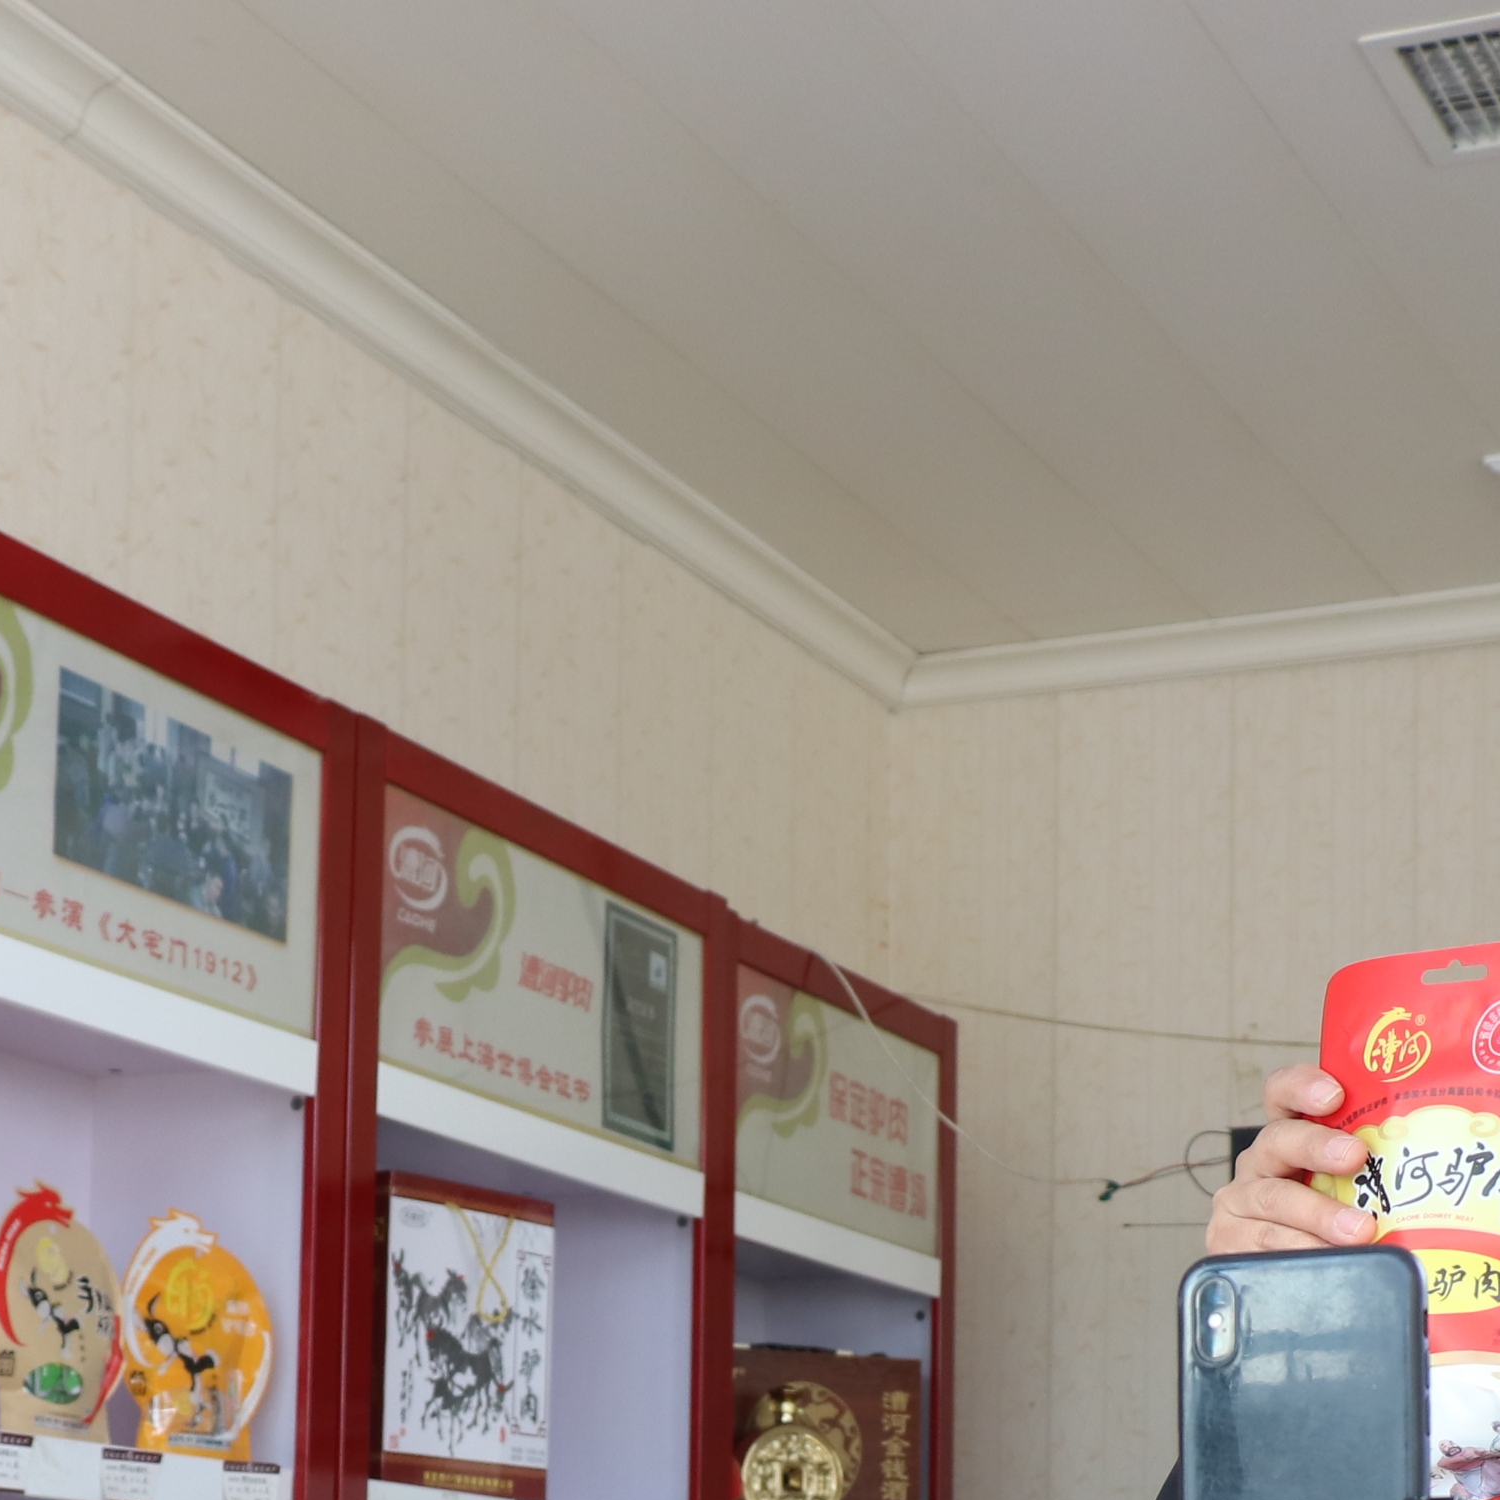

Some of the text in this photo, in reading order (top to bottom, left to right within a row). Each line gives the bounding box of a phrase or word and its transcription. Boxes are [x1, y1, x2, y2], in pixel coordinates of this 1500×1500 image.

[1396, 1212, 1475, 1224] CAOHE DONKEY MEAT
[520, 1265, 546, 1424] 徐水驴肉
